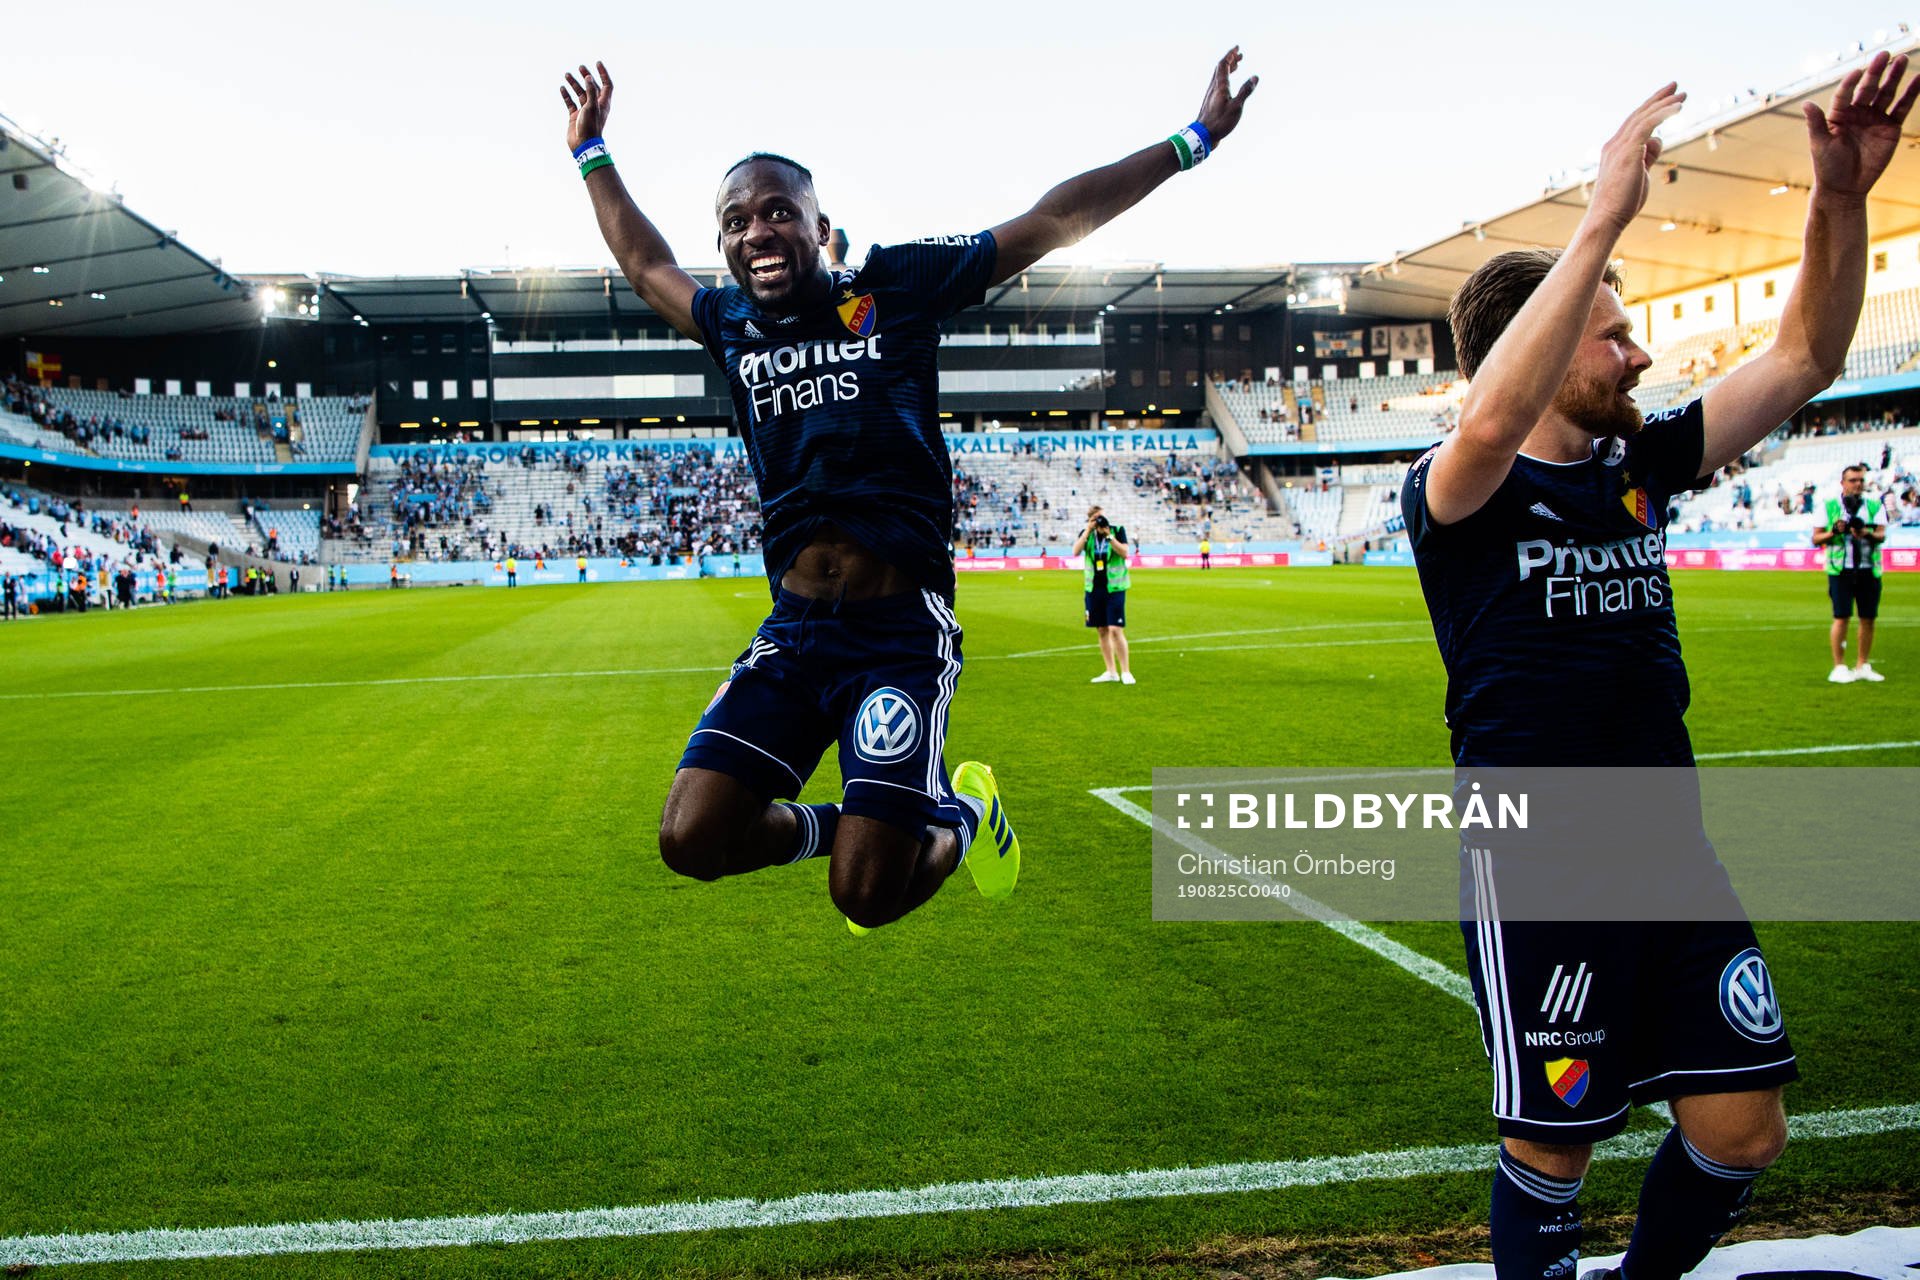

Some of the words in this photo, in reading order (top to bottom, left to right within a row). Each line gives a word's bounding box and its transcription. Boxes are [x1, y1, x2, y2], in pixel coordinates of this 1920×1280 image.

[739, 333, 882, 388] Prioritet
[751, 371, 860, 422] Finans
[565, 441, 610, 462] FÖR
[1074, 434, 1124, 451] INTE
[1131, 434, 1199, 451] FALLA
[1517, 527, 1666, 581] Prioritet
[1546, 574, 1664, 618] Finans
[1524, 1031, 1563, 1047] NRC
[1564, 1029, 1606, 1046] Group
[1538, 1224, 1563, 1233] NRC
